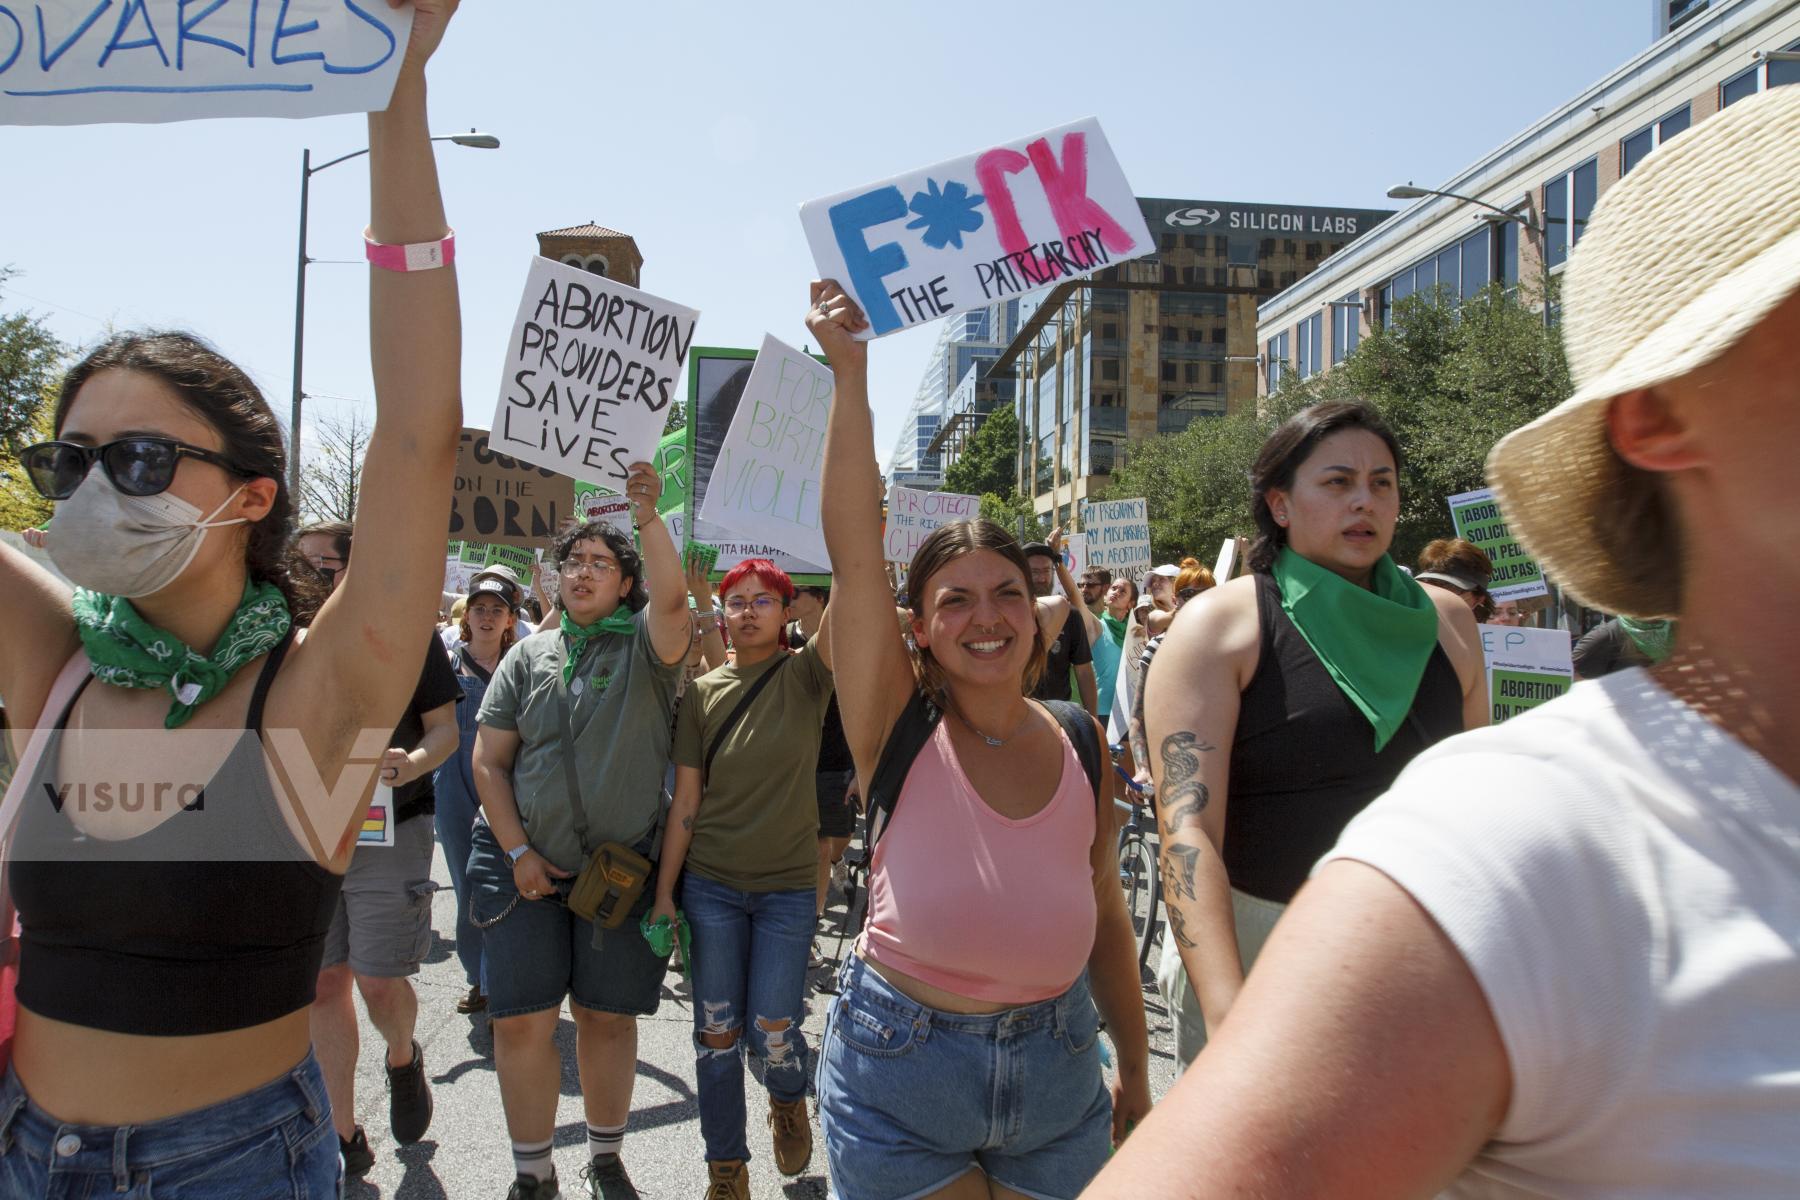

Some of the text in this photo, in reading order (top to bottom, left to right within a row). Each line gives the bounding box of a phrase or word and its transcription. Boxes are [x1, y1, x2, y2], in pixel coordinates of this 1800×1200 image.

[1230, 211, 1357, 234] SILICON LABS
[891, 228, 1110, 323] THE PATRIARCHY
[534, 278, 696, 368] ABORTION
[520, 321, 672, 413] PROVIDERS
[508, 370, 621, 436] SAVE
[722, 448, 820, 530] VIOLE
[897, 490, 979, 516] PROTECT
[894, 514, 915, 526] THE
[1083, 505, 1096, 524] MY
[1086, 527, 1099, 545] MY
[500, 547, 533, 565] WITHOUT
[1090, 544, 1150, 565] MY ABORTION
[1501, 679, 1562, 700] ABORTION
[1494, 703, 1510, 720] ON
